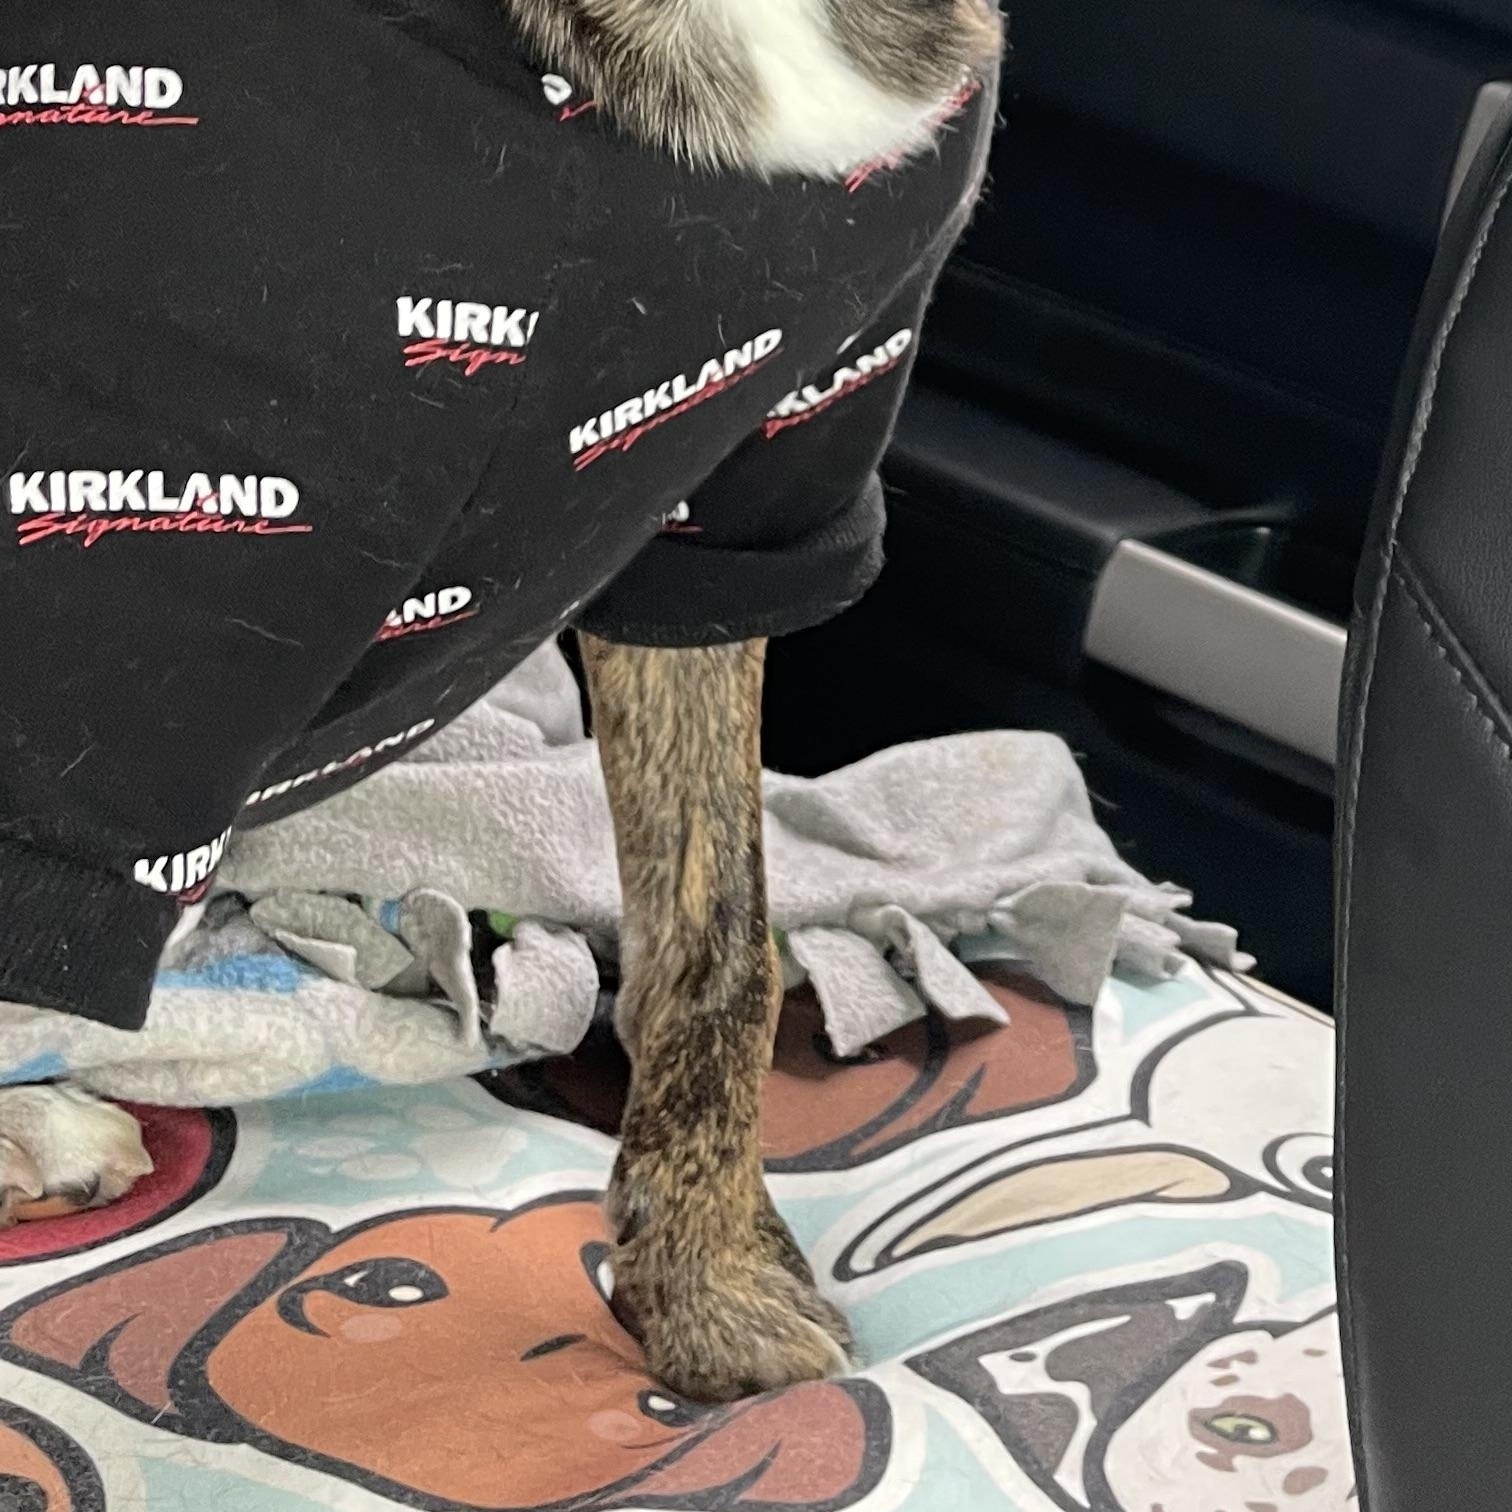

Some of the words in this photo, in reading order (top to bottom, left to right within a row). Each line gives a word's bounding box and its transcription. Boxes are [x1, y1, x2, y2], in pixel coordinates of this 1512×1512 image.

[0, 63, 184, 109] KLAND
[396, 295, 540, 348] KIRK
[569, 328, 783, 454] KIRKLAND
[766, 328, 912, 418] KLAND
[9, 469, 300, 519] KIRKLAND
[17, 510, 313, 548] Signature
[134, 825, 232, 893] KIRK
